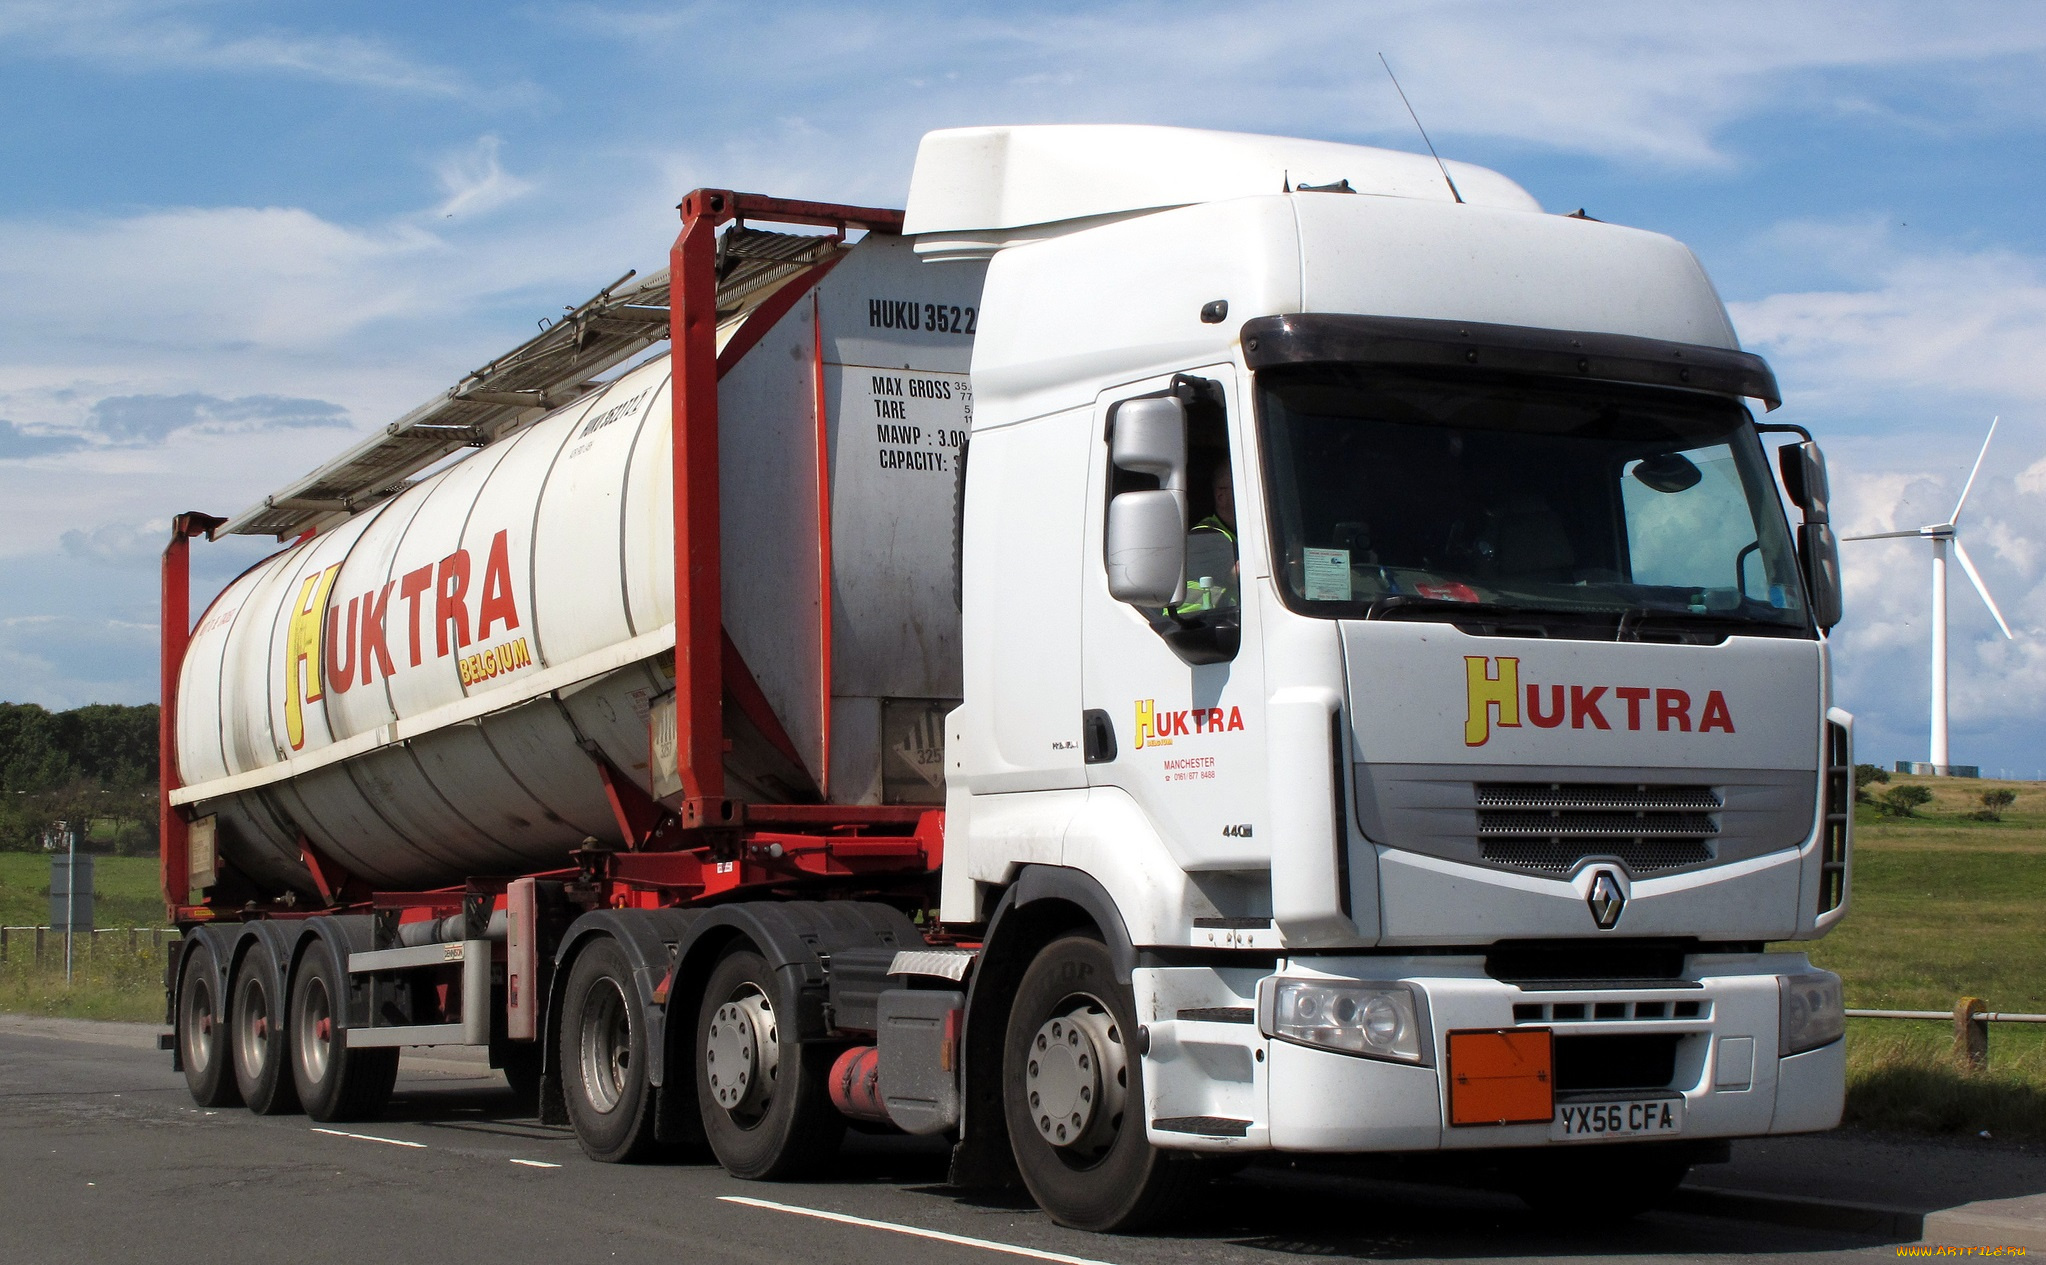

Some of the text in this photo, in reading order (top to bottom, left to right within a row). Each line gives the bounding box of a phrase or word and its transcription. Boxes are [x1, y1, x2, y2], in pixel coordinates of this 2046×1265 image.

[868, 299, 980, 335] HUKU 3522
[872, 376, 973, 399] MAX GROSS 35.
[874, 399, 973, 419] TARE 5.
[877, 424, 921, 445] MAWP
[937, 429, 966, 448] 3.00
[879, 449, 948, 472] CAPACITY:
[284, 528, 520, 751] HUKTRA
[459, 636, 532, 687] BELGIUM
[1463, 655, 1736, 747] HUKTRA
[1134, 699, 1245, 749] HUKTRA
[1164, 757, 1215, 770] MANCHESTER
[1222, 824, 1245, 838] 440
[1561, 1102, 1672, 1134] YX56 CFA
